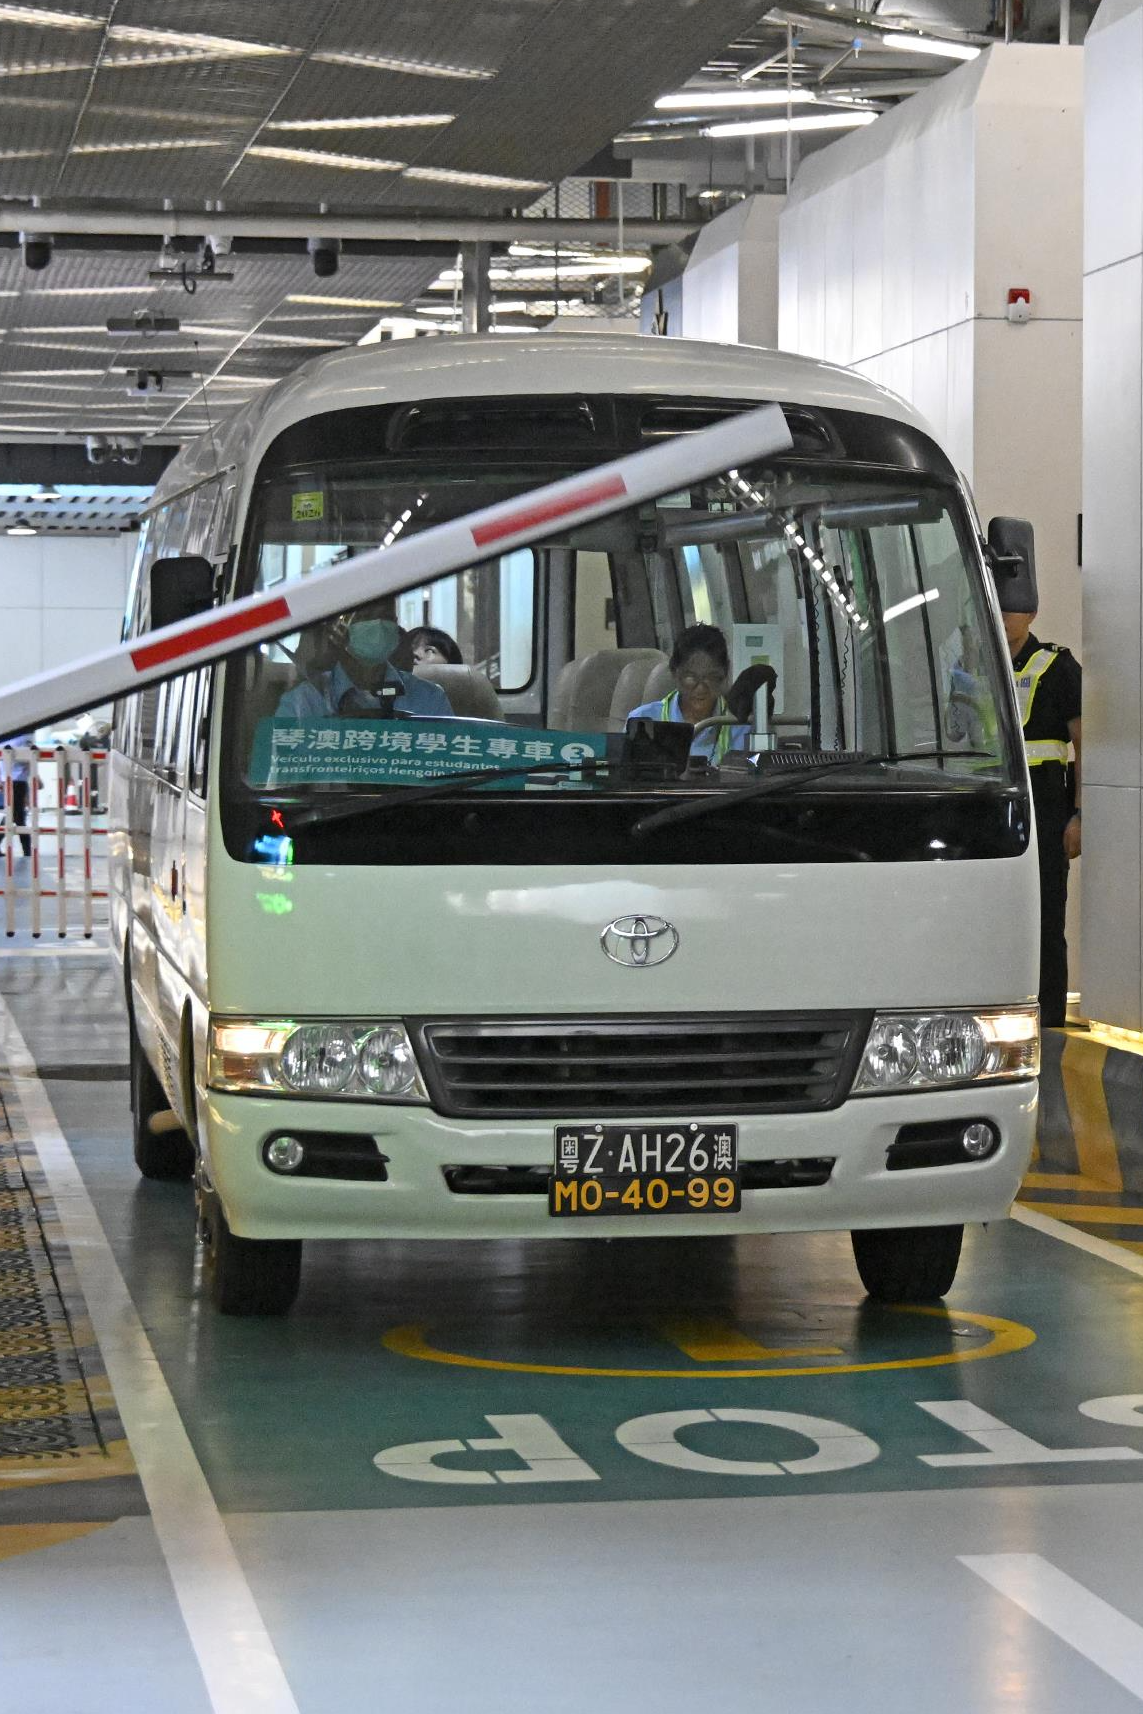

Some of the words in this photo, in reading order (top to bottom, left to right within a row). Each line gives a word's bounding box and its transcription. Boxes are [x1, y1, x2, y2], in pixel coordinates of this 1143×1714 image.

[272, 728, 555, 762] 琴澳跨境學生專車
[271, 754, 321, 764] Veículo
[323, 754, 388, 765] exclusivo
[390, 757, 422, 769] para
[271, 764, 386, 776] transfronteiriços
[555, 1176, 735, 1212] MO-40-99
